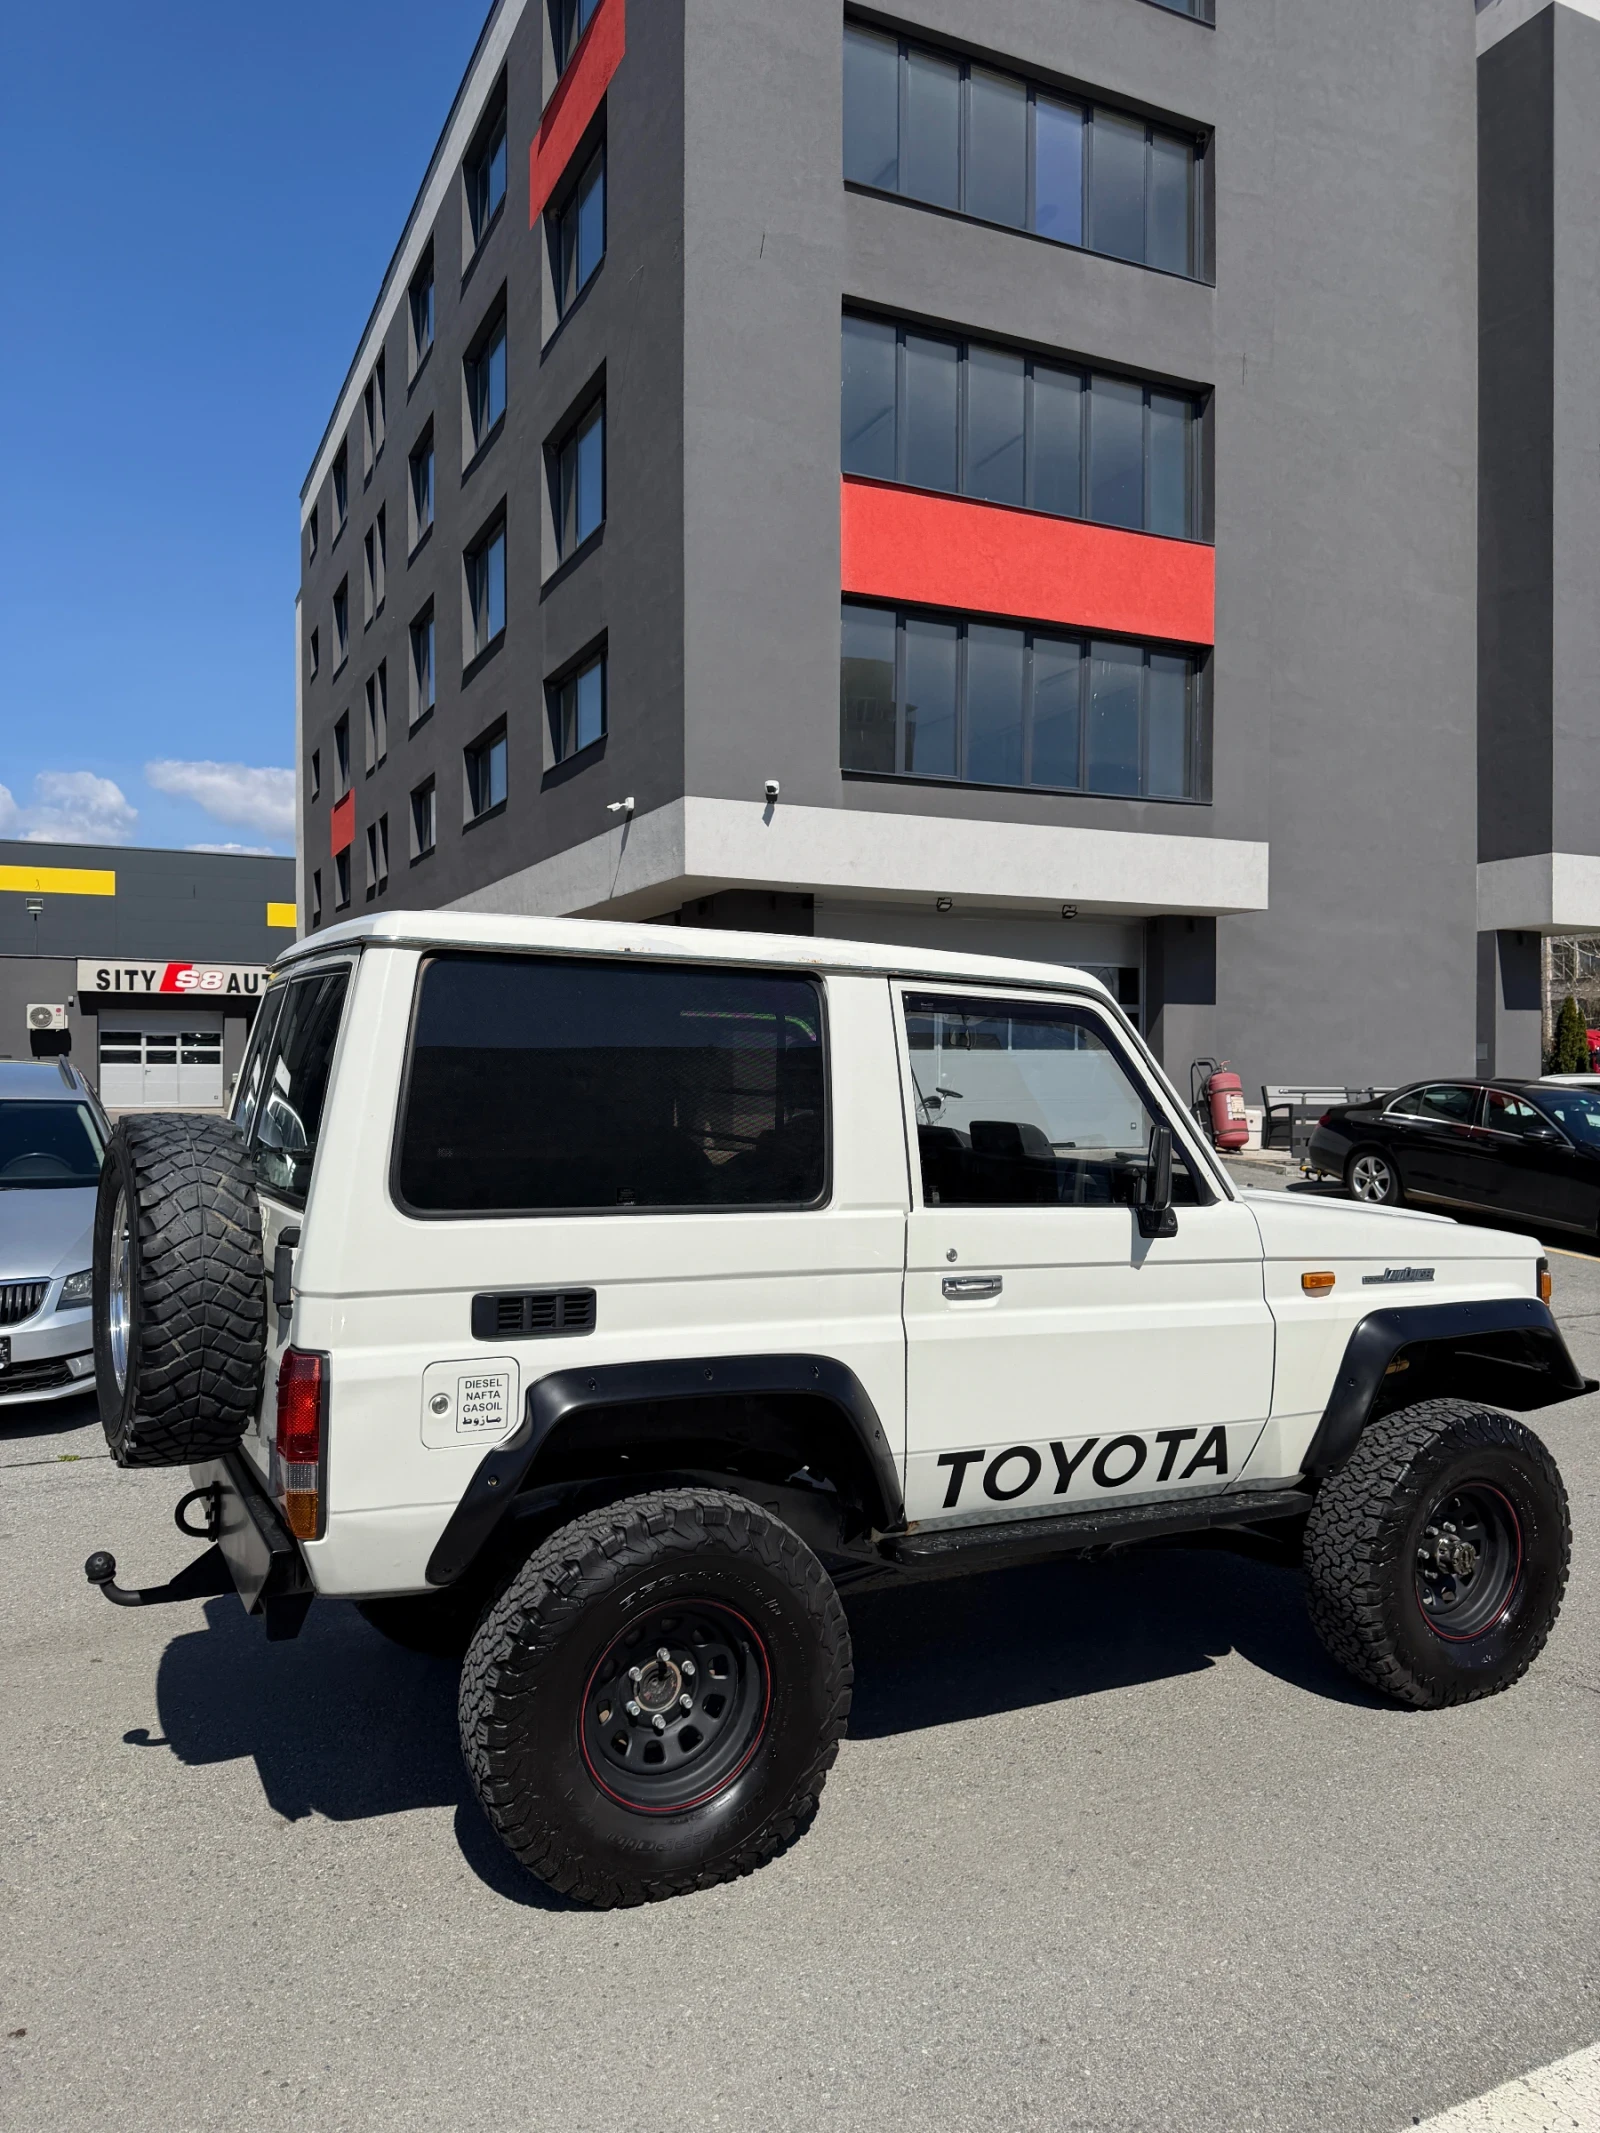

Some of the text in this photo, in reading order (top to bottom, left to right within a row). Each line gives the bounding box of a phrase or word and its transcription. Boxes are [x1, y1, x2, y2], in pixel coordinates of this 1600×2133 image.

[96, 969, 156, 990] SITY
[174, 969, 225, 990] S8
[465, 1378, 503, 1389] DIESEL
[466, 1390, 501, 1401] NAFTA
[462, 1402, 503, 1413] GASOIL
[937, 1425, 1228, 1508] TOYOTA
